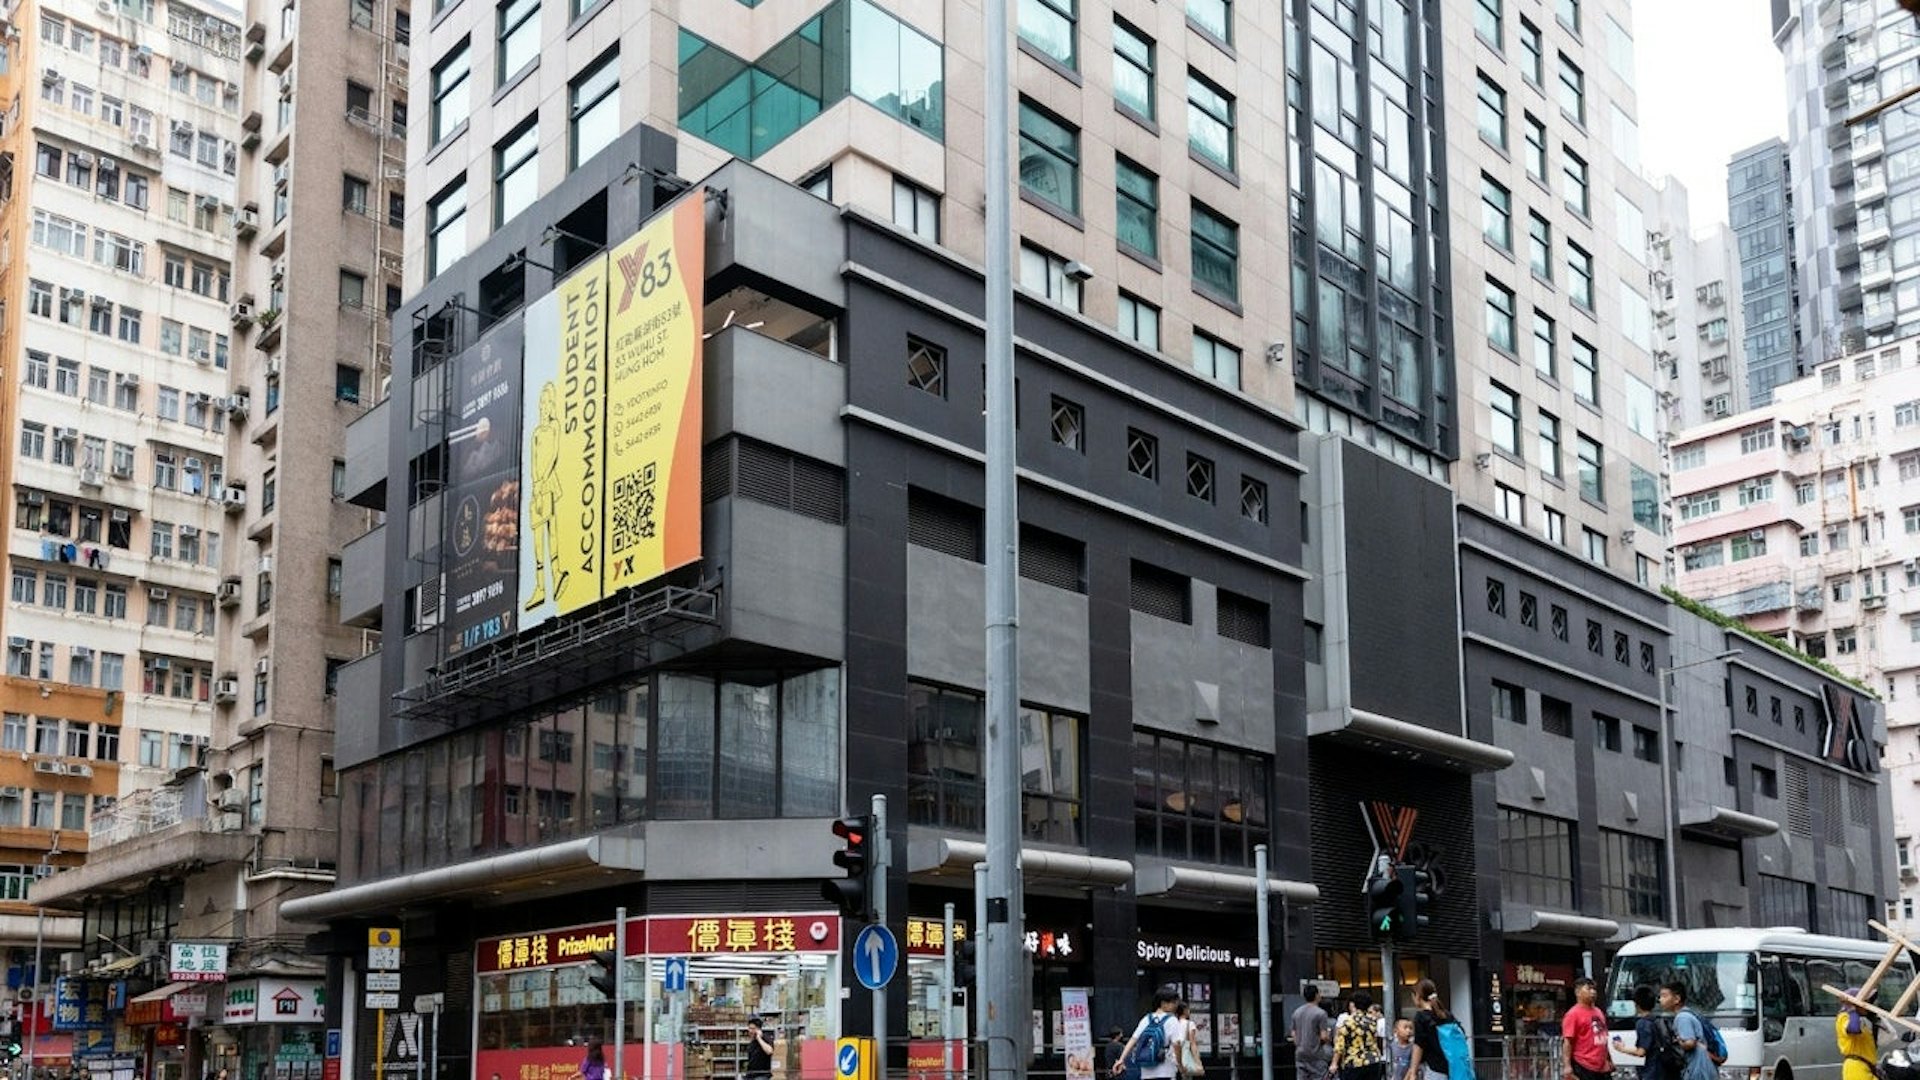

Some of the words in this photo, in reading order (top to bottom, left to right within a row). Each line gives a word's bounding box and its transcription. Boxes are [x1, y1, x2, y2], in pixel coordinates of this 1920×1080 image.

[566, 292, 580, 434] STUDENT
[643, 347, 665, 367] HOM
[581, 277, 599, 574] ACCOMMODATION
[559, 932, 615, 956] PrizeMart
[1137, 940, 1172, 963] Spicy
[1176, 944, 1231, 962] Delicious
